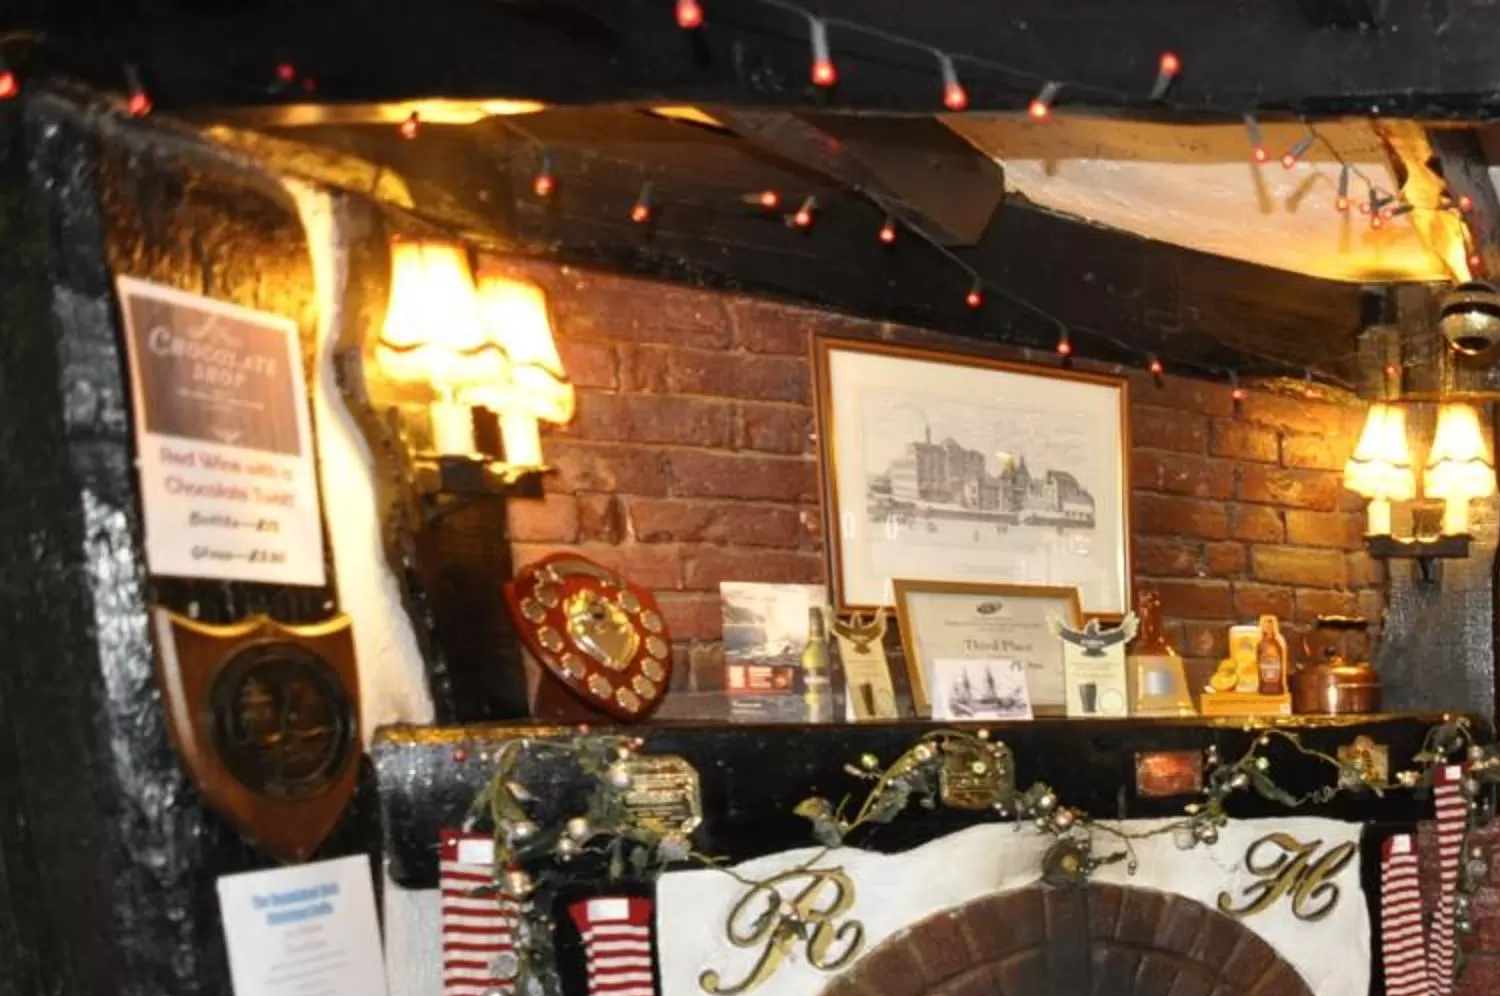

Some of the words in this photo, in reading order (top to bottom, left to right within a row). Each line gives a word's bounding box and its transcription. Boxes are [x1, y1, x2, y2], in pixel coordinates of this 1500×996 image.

[160, 447, 195, 467] Red
[198, 452, 241, 473] Wine
[165, 474, 248, 501] Chocolate
